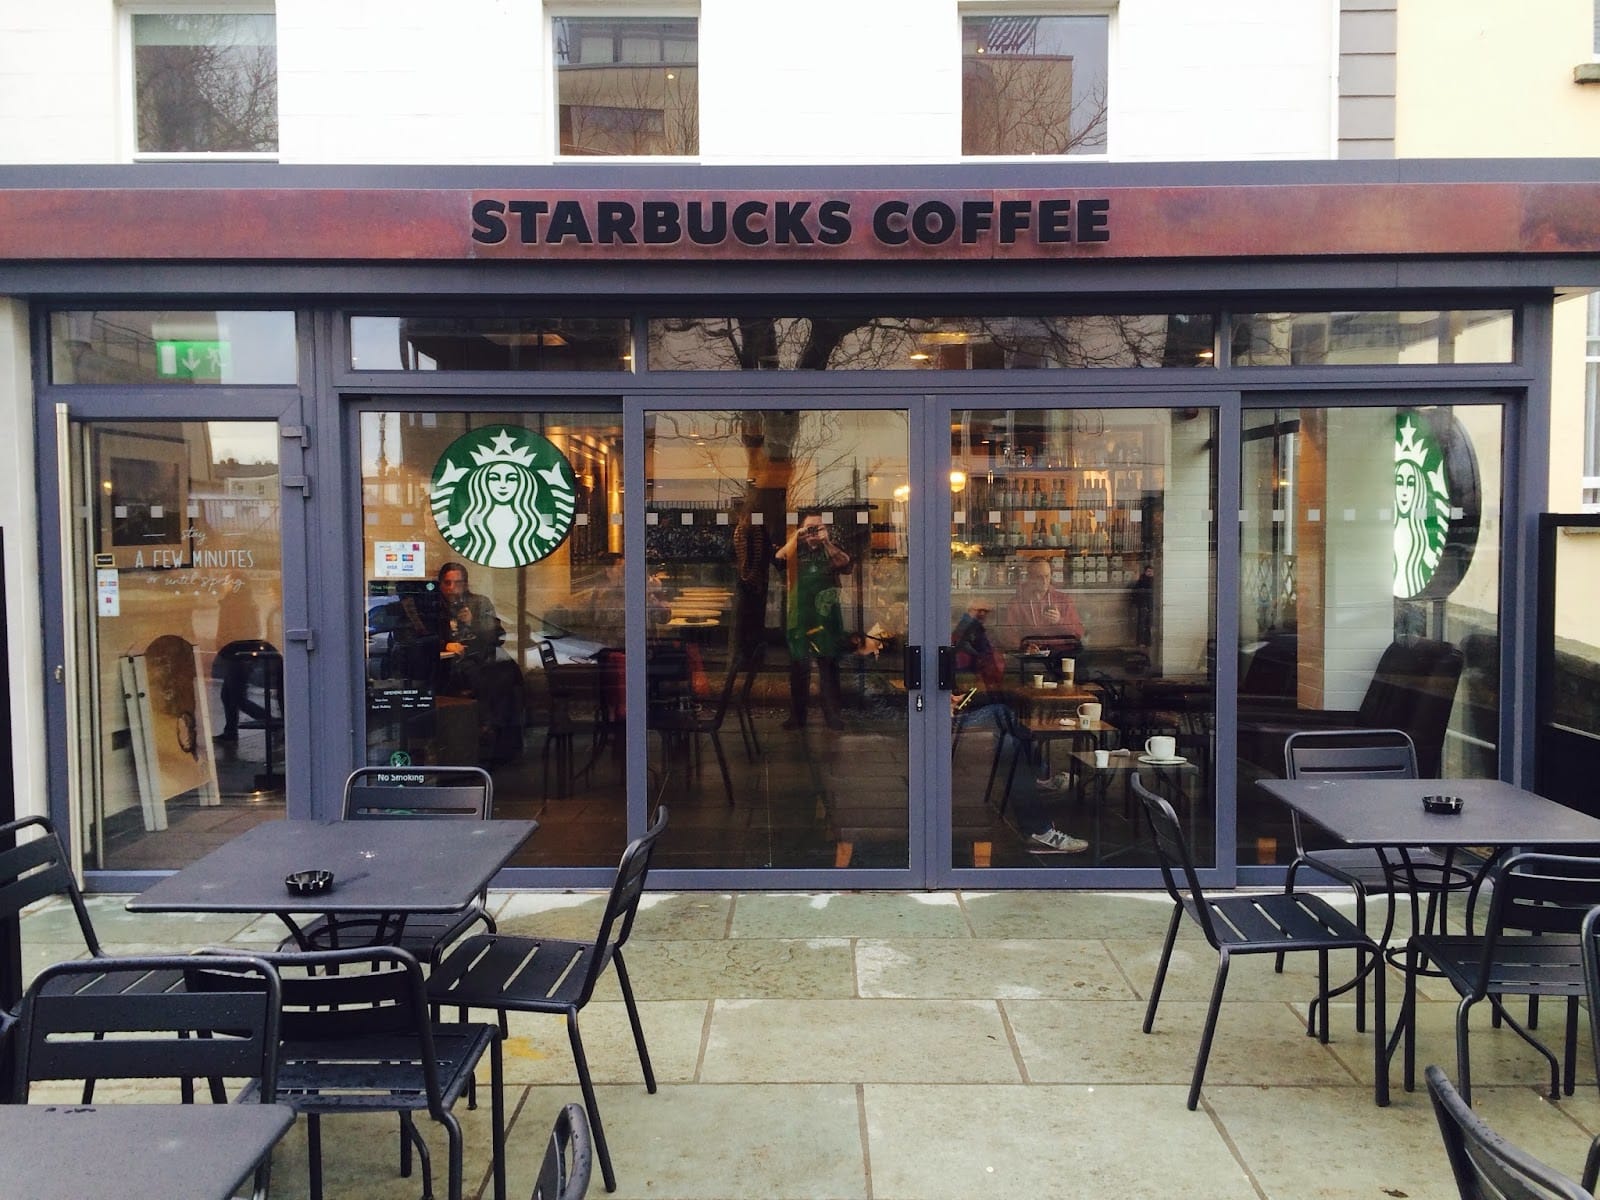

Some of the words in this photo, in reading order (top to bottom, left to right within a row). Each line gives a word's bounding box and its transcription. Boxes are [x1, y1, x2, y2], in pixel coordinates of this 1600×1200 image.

[471, 199, 852, 245] STARBUCKS
[873, 199, 1110, 244] COFFEE
[181, 526, 208, 545] stay
[135, 550, 144, 568] A
[153, 550, 183, 568] FEW
[192, 550, 254, 568] MINUTES
[377, 774, 390, 782] No
[391, 774, 425, 784] Smoking
